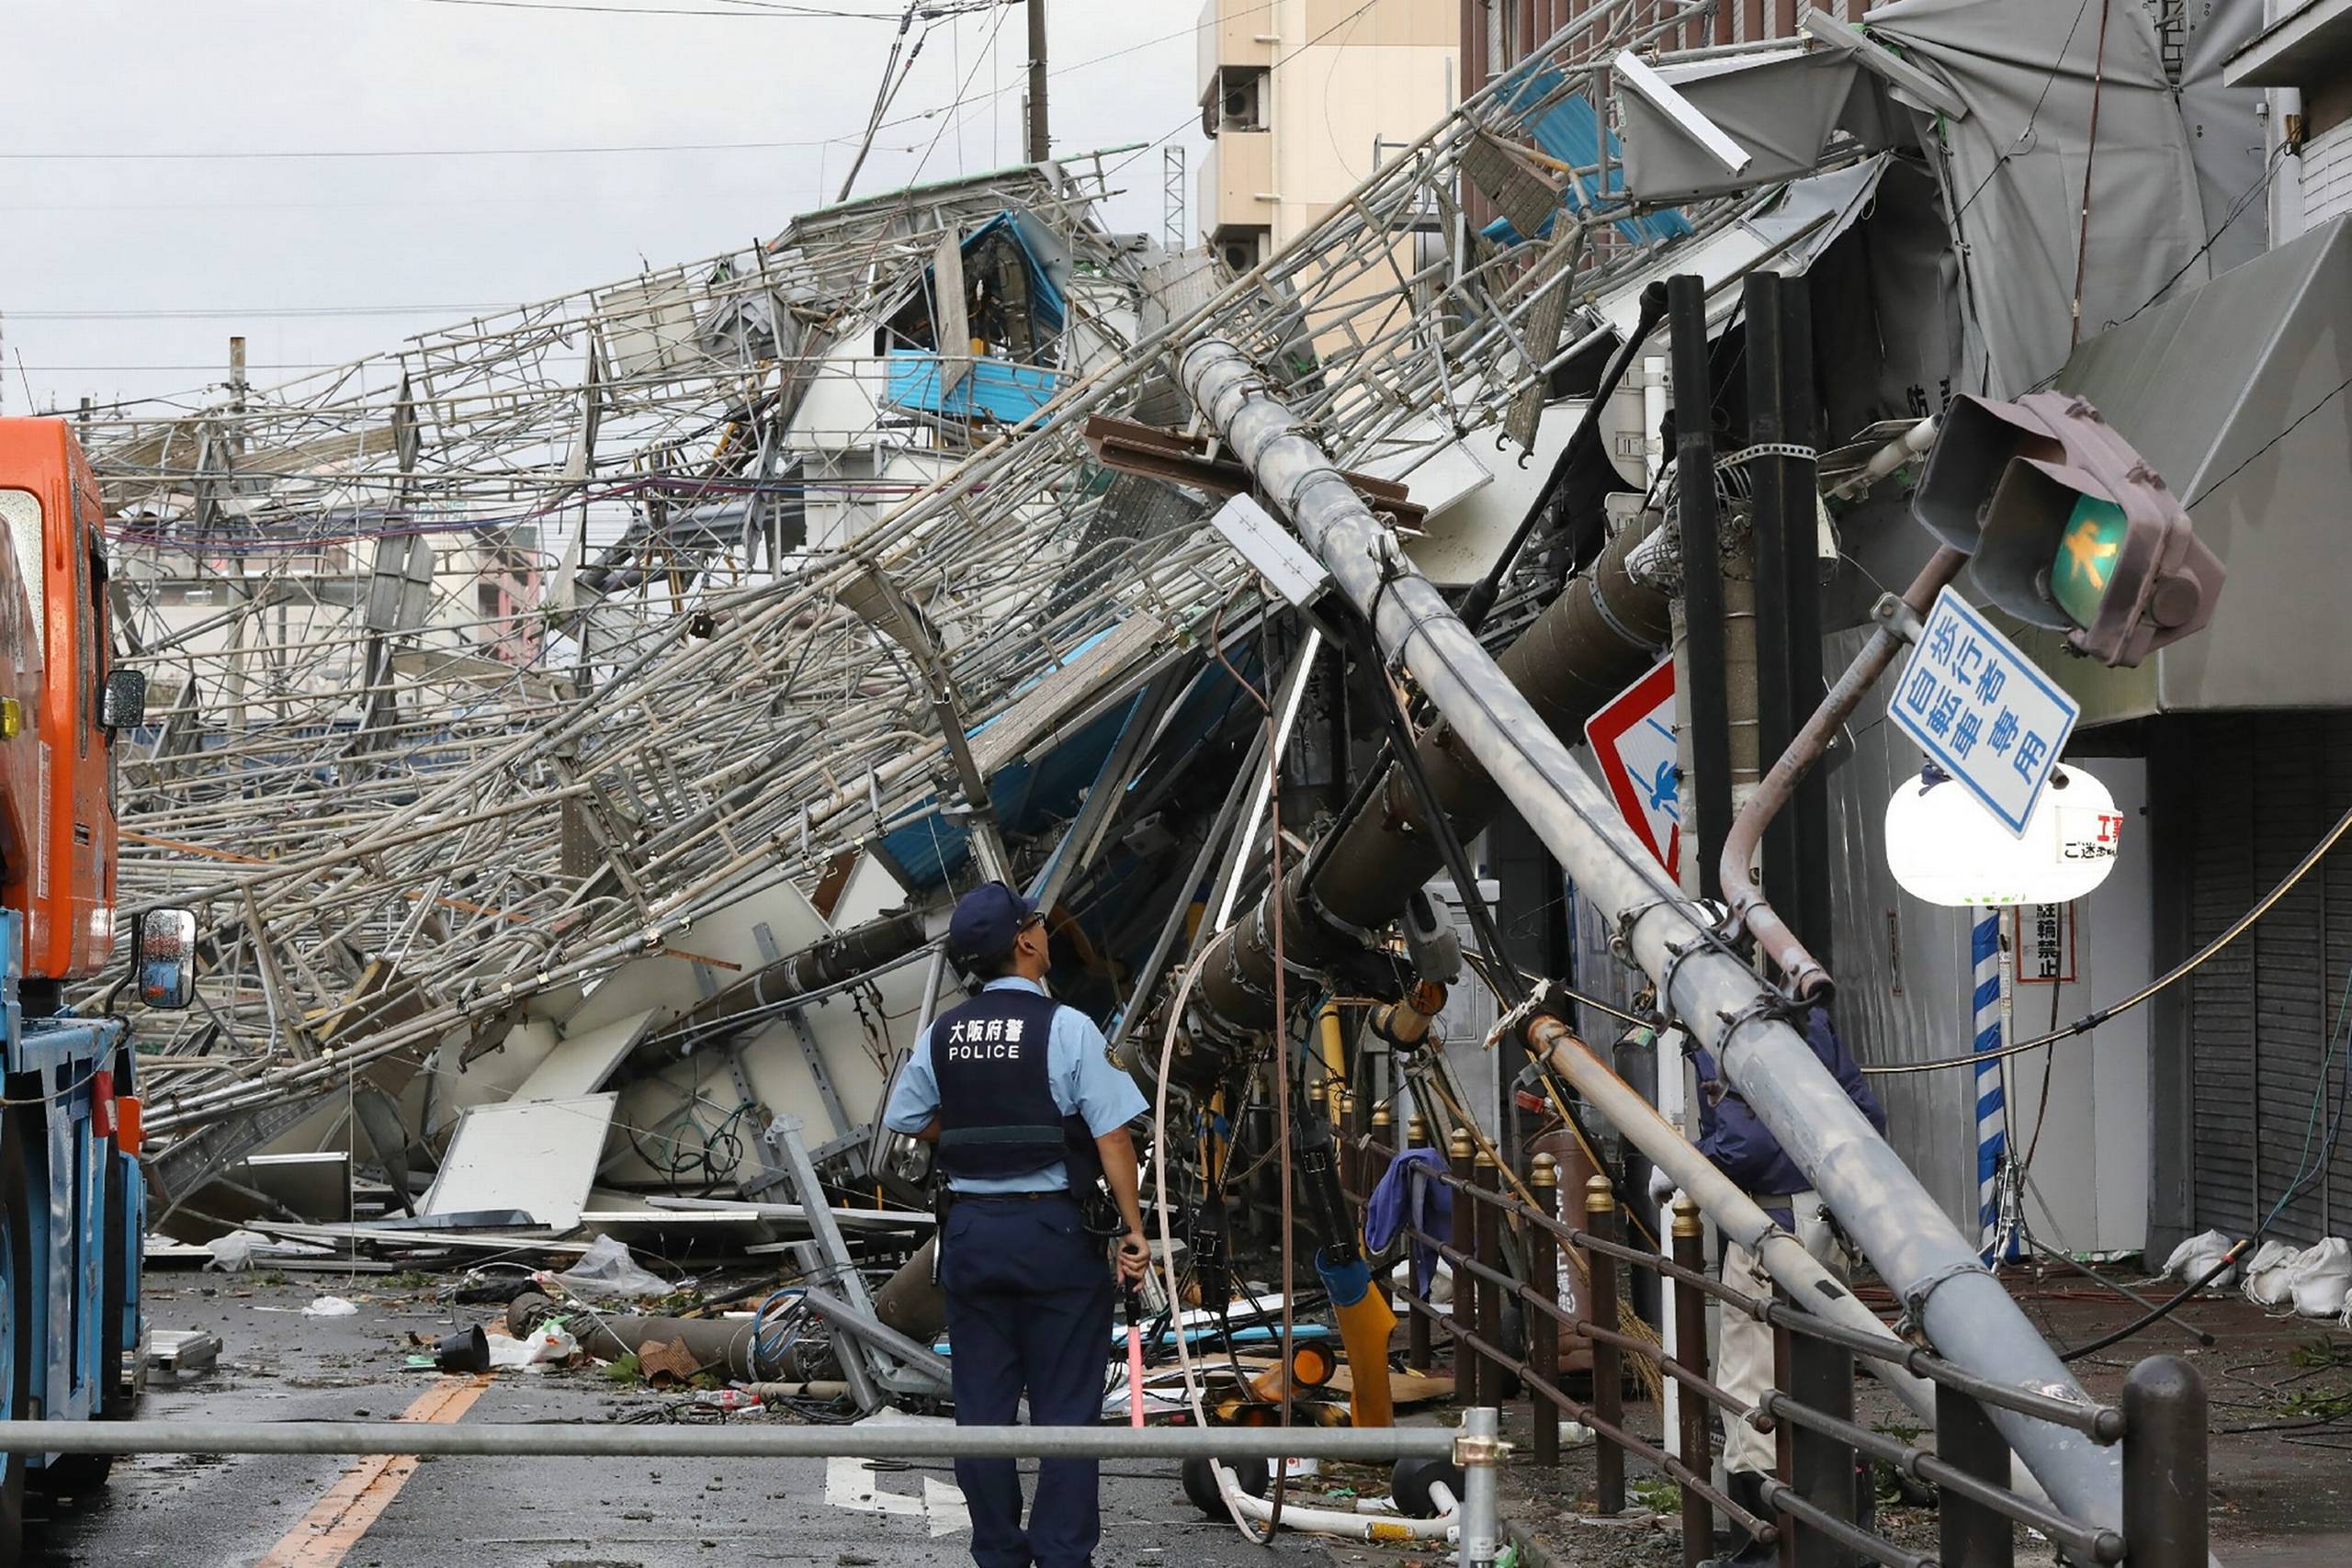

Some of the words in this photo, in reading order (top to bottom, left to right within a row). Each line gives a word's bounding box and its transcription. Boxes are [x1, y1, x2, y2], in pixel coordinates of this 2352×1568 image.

[1929, 615, 2007, 706] 歩行者
[1906, 666, 1984, 761] 自転車
[1986, 705, 2047, 785] 専用
[949, 1019, 1024, 1044] 大阪府警
[949, 1044, 1020, 1061] POLICE
